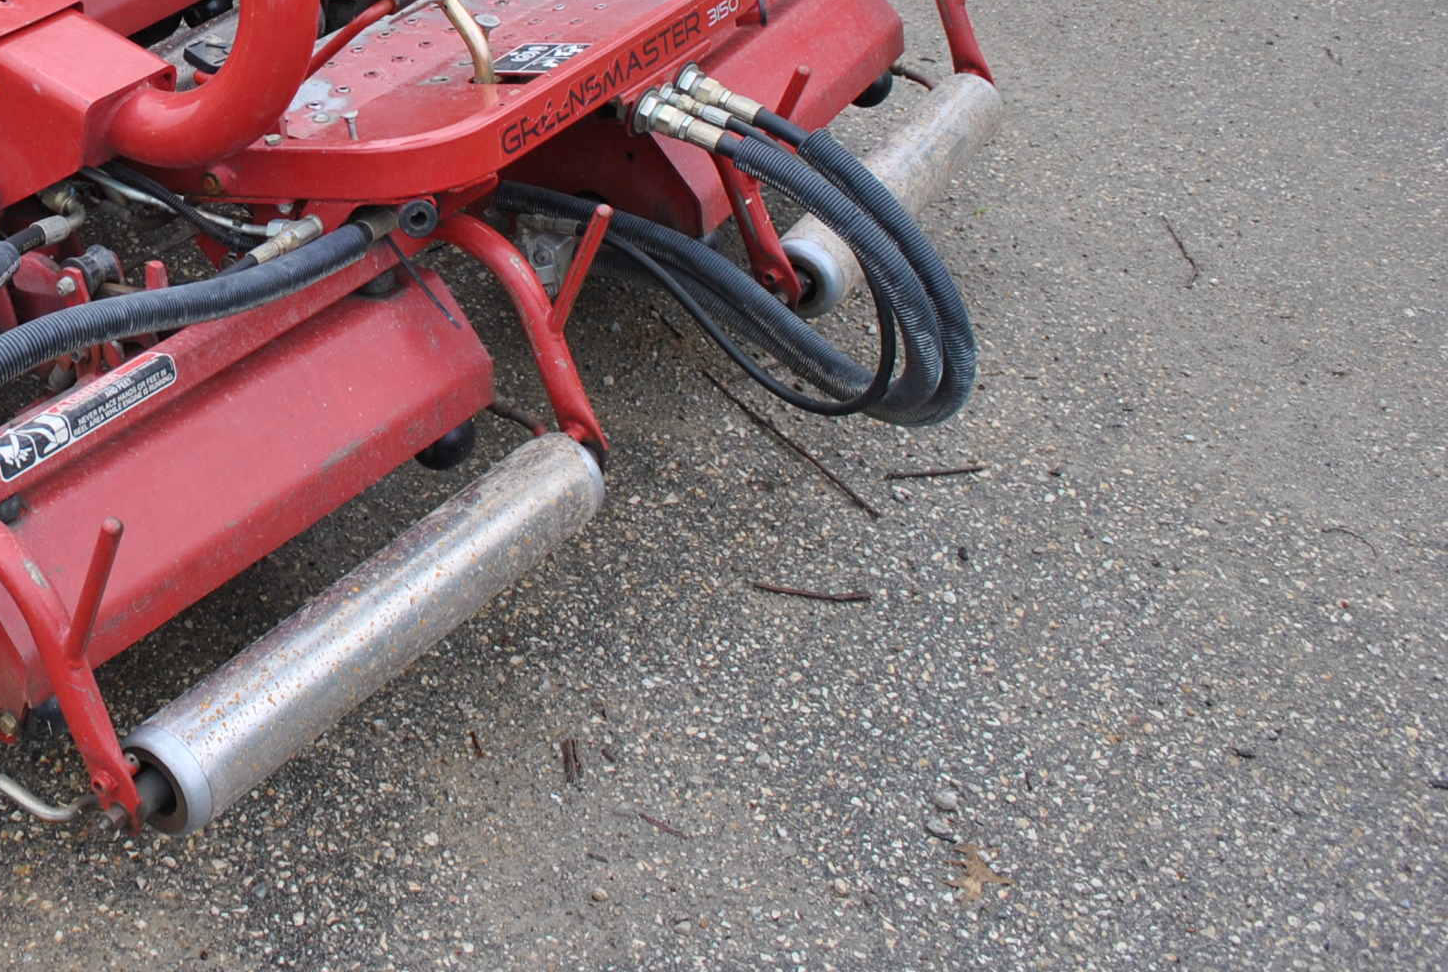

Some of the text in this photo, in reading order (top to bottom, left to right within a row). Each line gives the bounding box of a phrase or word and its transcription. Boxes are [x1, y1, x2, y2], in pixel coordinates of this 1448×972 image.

[73, 425, 89, 437] REEL
[89, 414, 105, 427] AREA
[104, 403, 123, 418] WHILE
[122, 391, 143, 407] ENGINE
[143, 388, 149, 396] IS
[148, 373, 173, 392] RUNNING
[78, 408, 98, 426] NEVER
[98, 397, 118, 414] PLACE
[117, 386, 137, 403] HANDS
[136, 380, 146, 391] OR
[146, 371, 160, 386] FEET
[160, 368, 167, 377] IN
